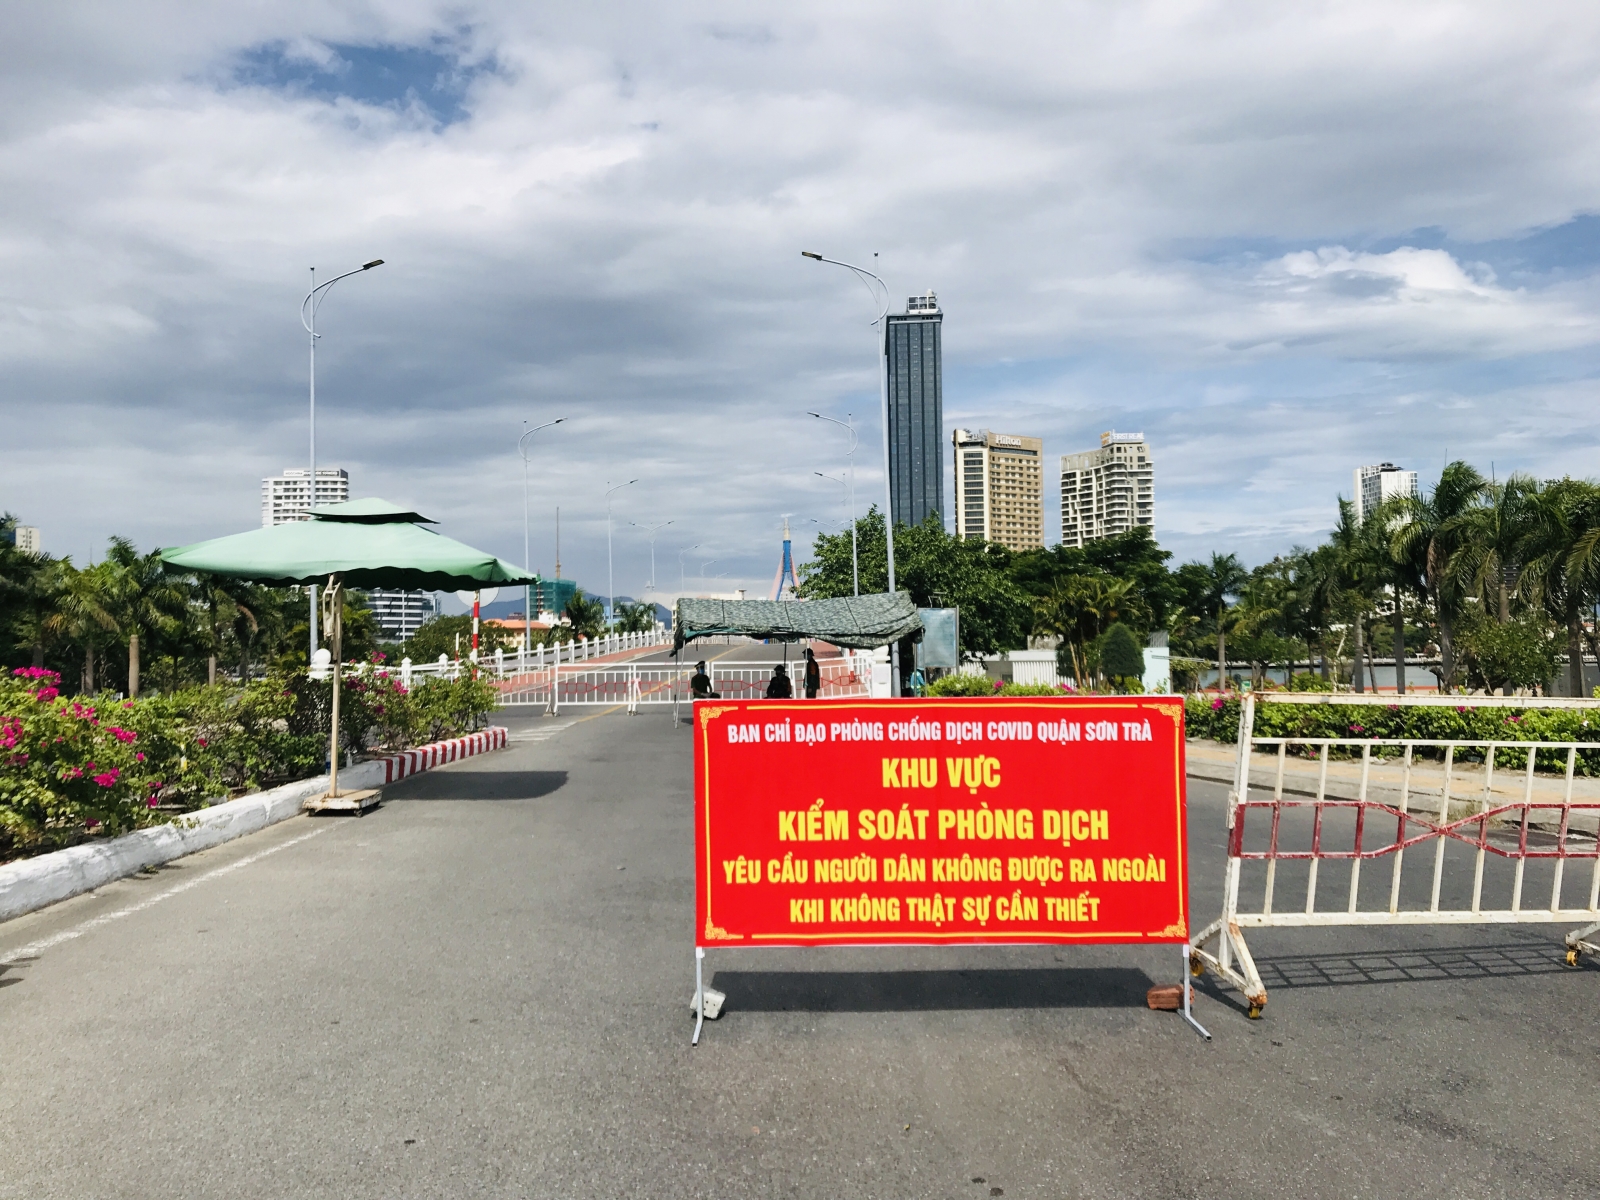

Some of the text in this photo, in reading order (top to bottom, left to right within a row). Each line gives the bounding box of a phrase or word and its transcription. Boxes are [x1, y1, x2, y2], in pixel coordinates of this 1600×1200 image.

[996, 434, 1021, 446] Hilton
[728, 716, 1152, 746] BAN CHỈ ĐẠO PHÒNG CHỐNG DỊCH COVID QUẬN SƠN TRÀ
[882, 755, 1000, 794] KHU VỰC
[779, 798, 1108, 847] KIỂM SOÁT PHÒNG DỊCH
[723, 852, 1166, 886] YÊU CẦU NGƯỜI DÂN KHÔNG ĐƯỢC RA NGOÀI
[790, 889, 1100, 927] KHI KHÔNG THẬT SỰ CẦN THIẾT
